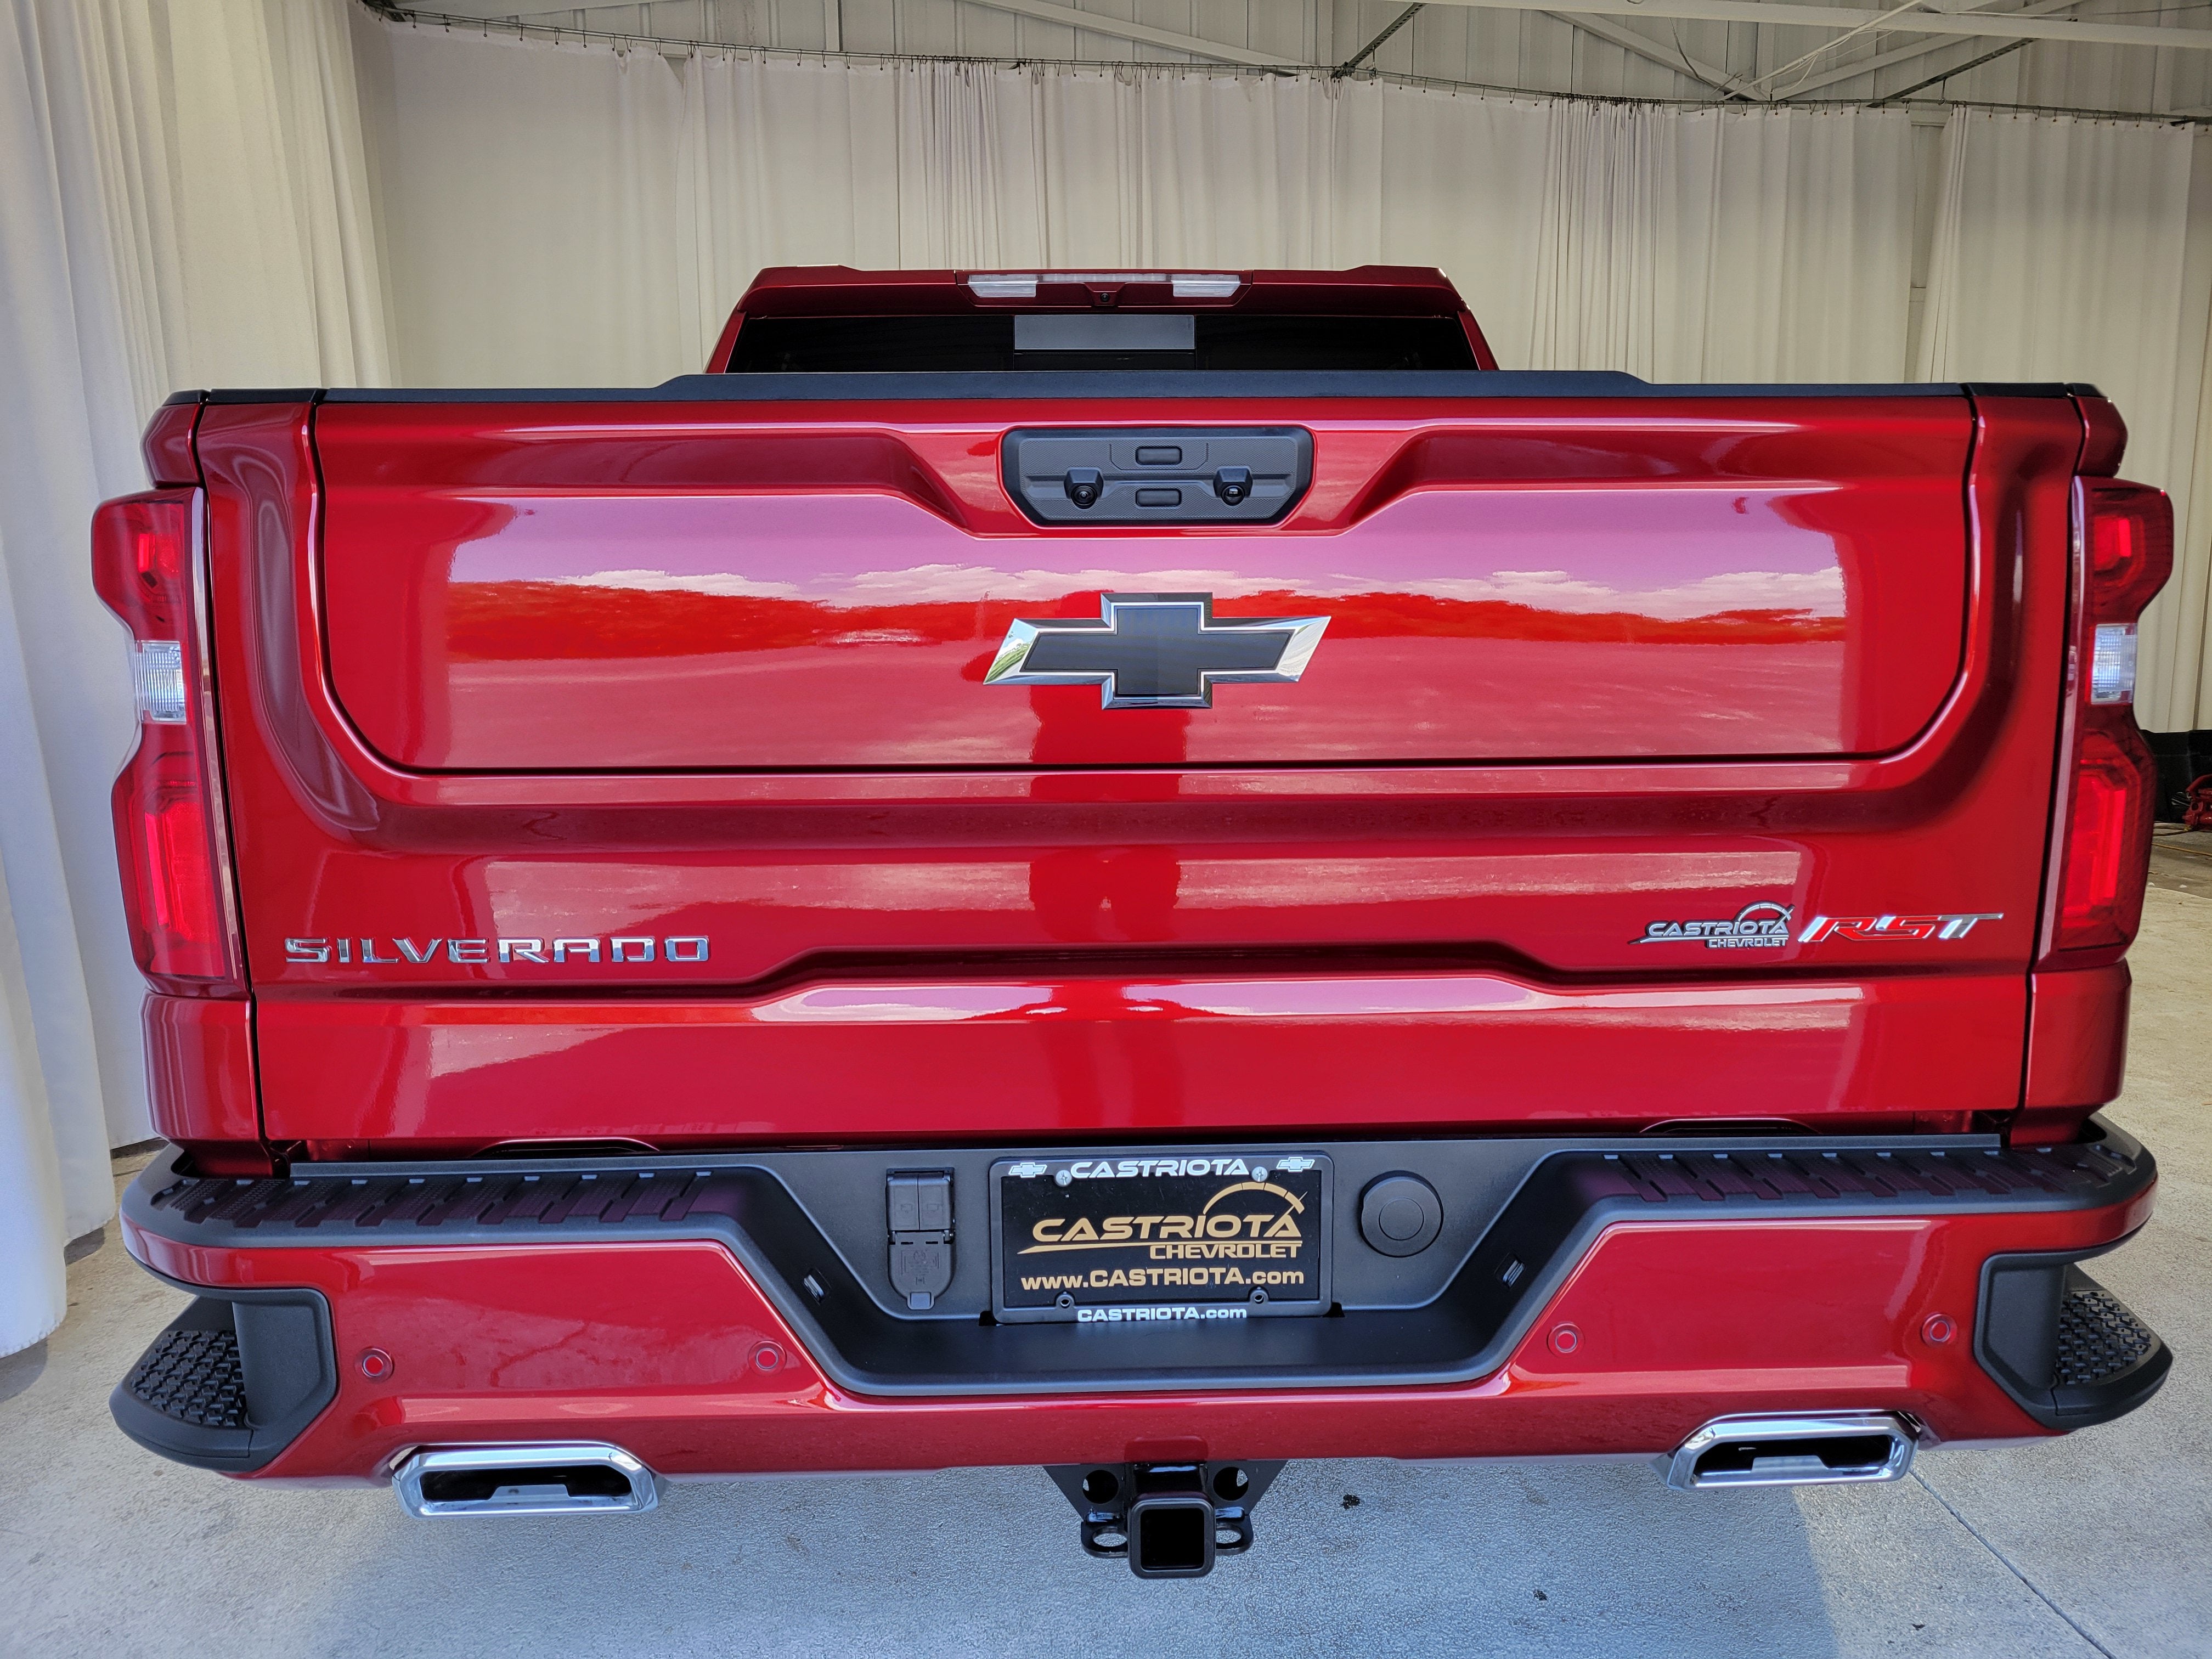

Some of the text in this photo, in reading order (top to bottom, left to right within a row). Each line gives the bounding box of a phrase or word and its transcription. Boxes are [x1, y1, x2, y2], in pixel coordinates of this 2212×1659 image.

[1647, 921, 1790, 936] CASTRIOTA
[1798, 913, 2004, 943] RST
[285, 936, 710, 964] SILVERADO
[1707, 936, 1787, 949] CHEVROLET
[1070, 1158, 1250, 1178] CASTRIOTA
[1032, 1215, 1302, 1242] CASTRIOTA
[1150, 1244, 1302, 1259] CHEVROLET
[1021, 1268, 1304, 1290] www.CASTRIOTA.com
[1077, 1307, 1248, 1322] CASTRIOTA.com
